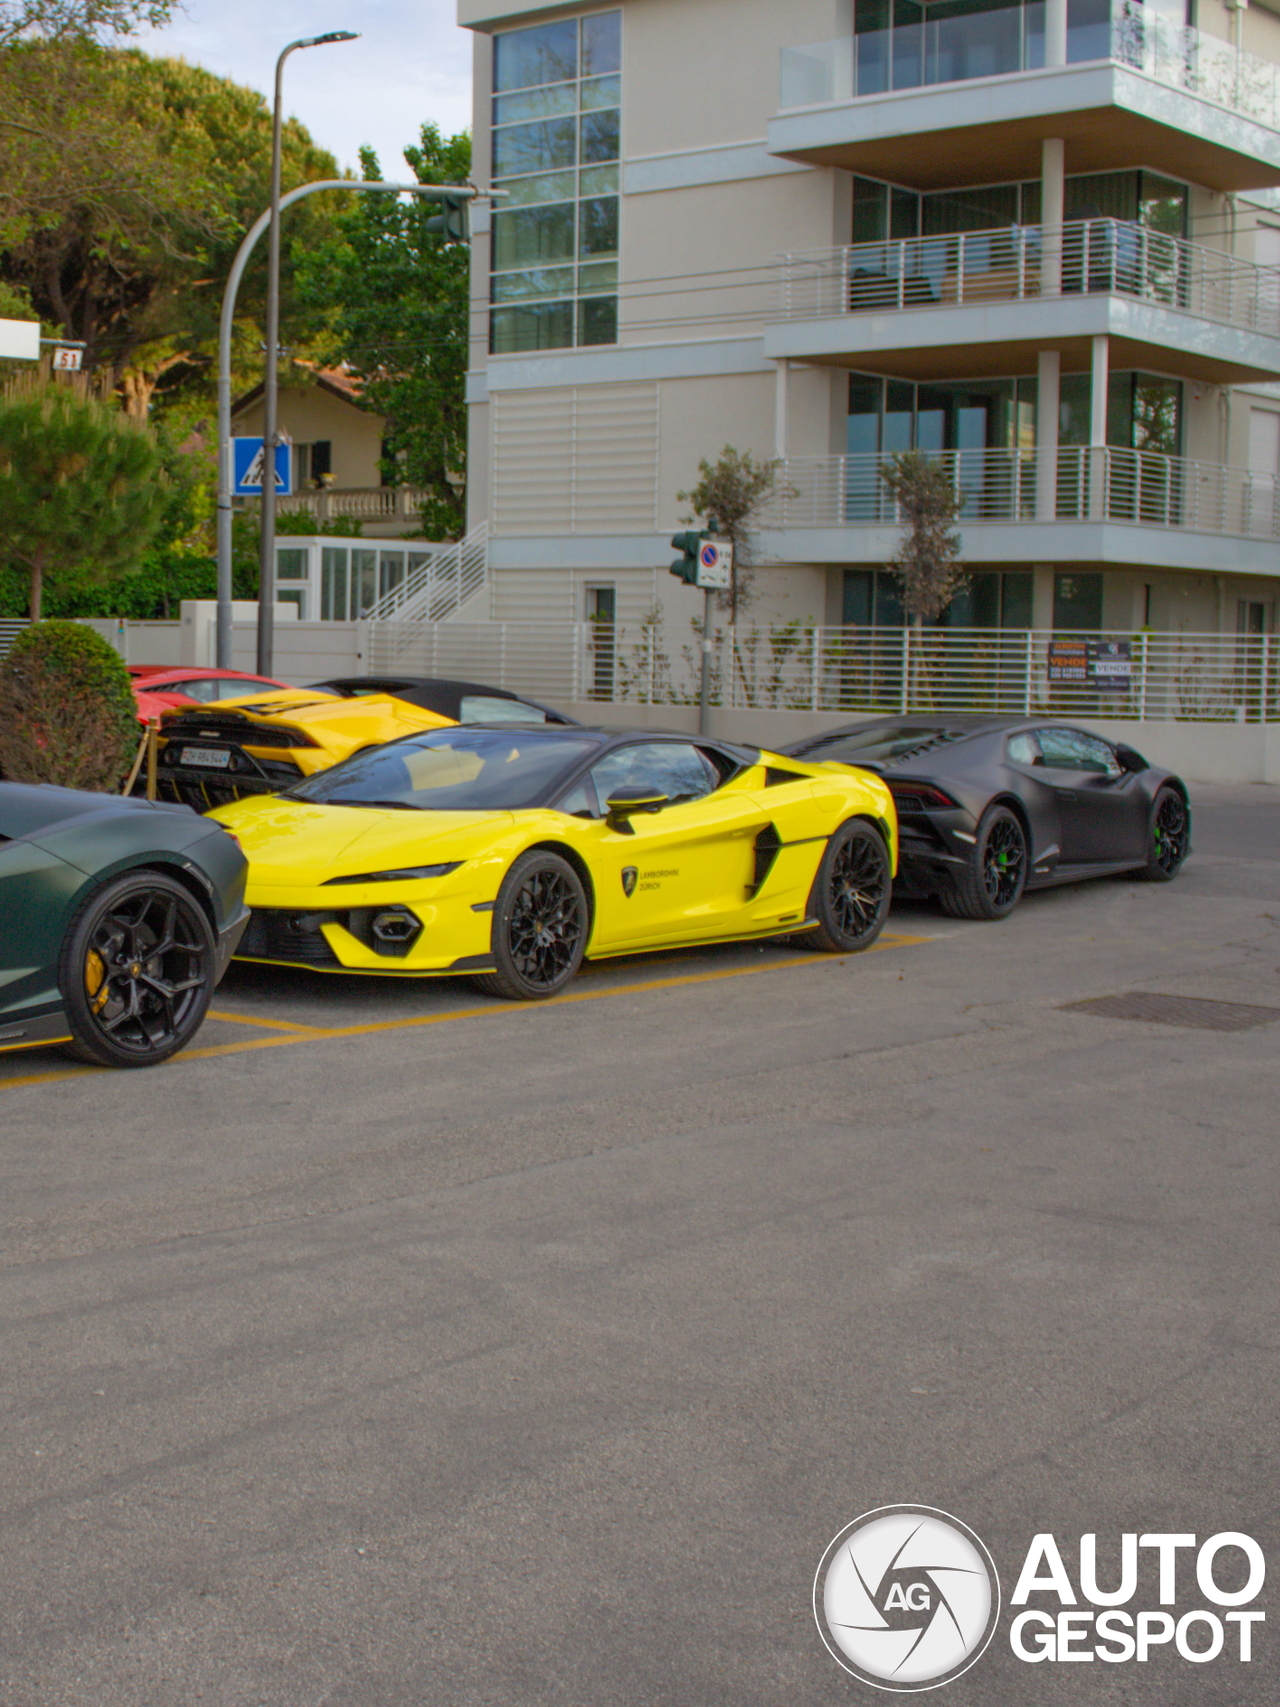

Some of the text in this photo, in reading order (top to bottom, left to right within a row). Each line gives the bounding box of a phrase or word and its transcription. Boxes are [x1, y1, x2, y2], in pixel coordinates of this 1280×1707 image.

[61, 353, 77, 368] 51
[1050, 658, 1087, 667] VENDE
[1097, 664, 1130, 672] VENDE
[640, 869, 680, 880] LAMBORGHINI
[640, 882, 661, 891] ZÜRICH
